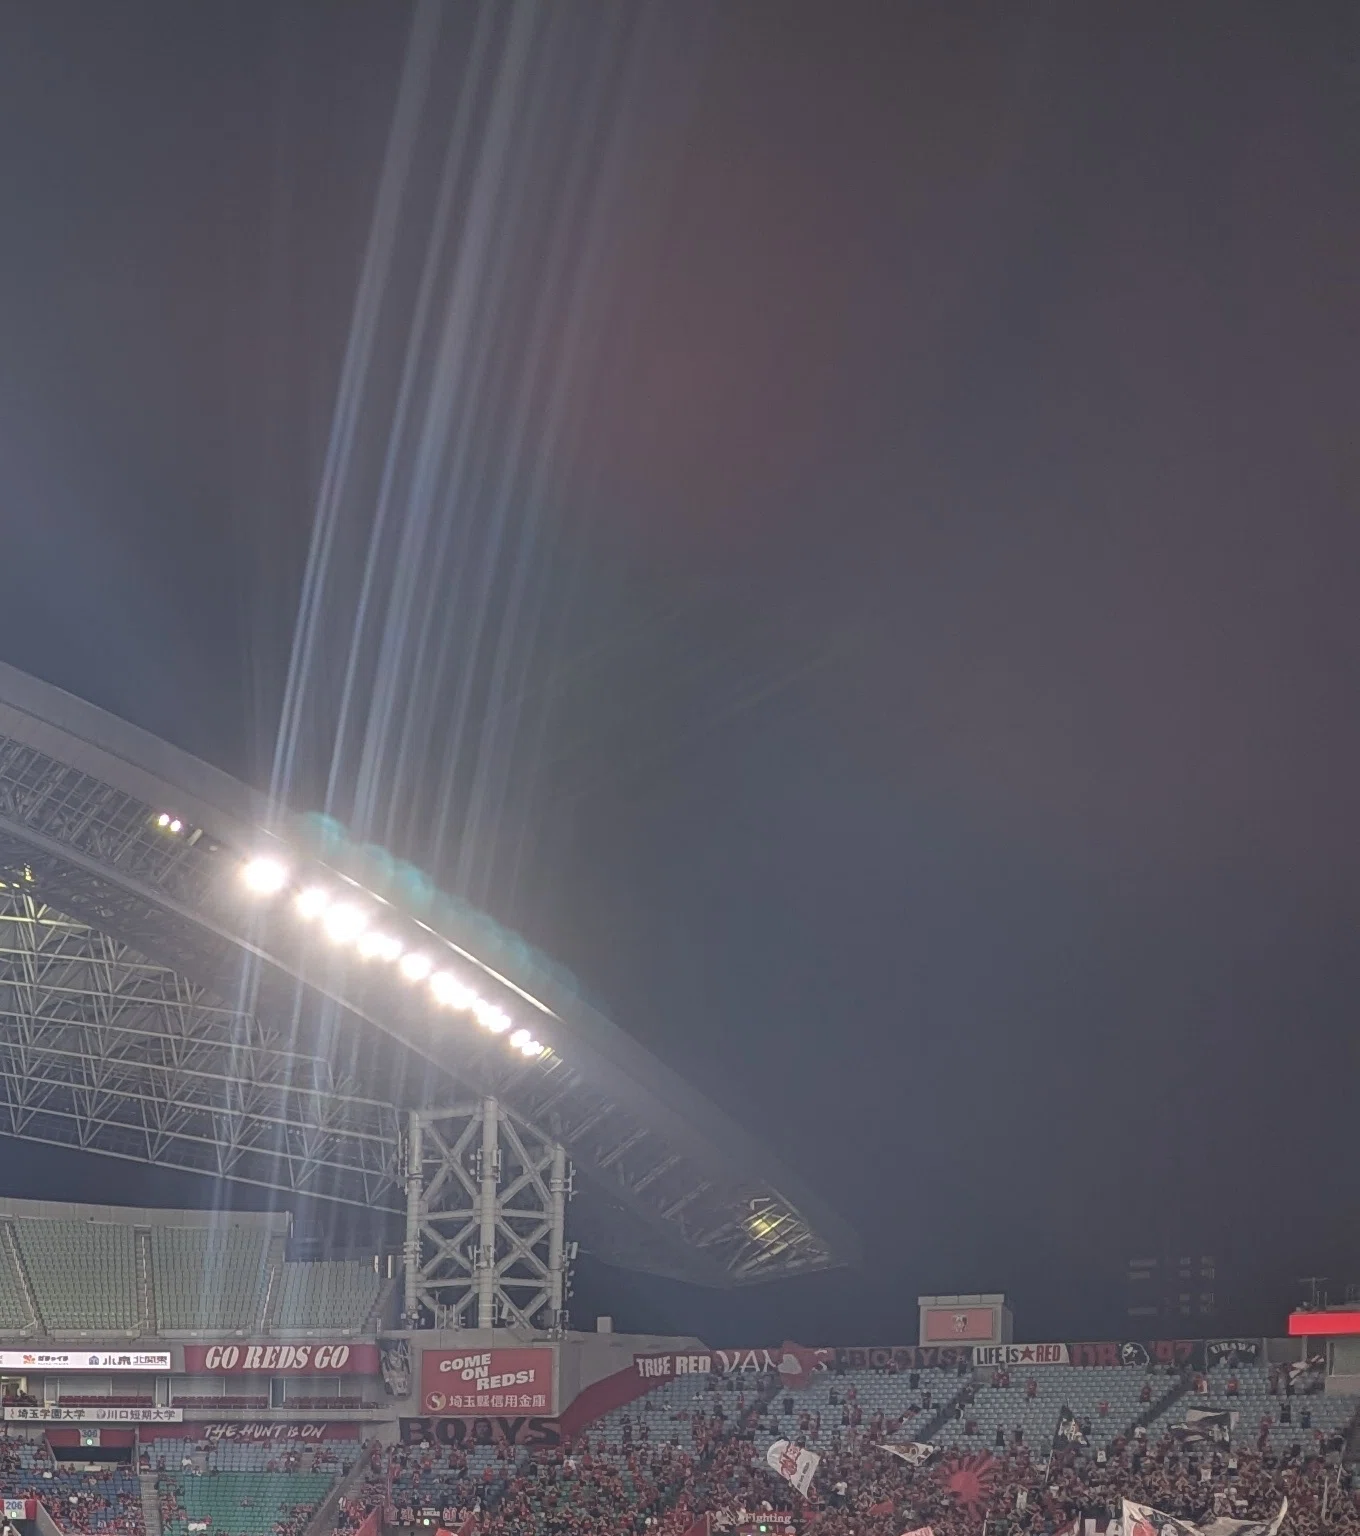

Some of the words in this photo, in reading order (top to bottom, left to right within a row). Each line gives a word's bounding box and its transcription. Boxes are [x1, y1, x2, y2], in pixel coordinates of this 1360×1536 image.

[205, 1345, 240, 1369] GO
[242, 1345, 312, 1369] REDS
[314, 1345, 350, 1369] GO
[439, 1353, 492, 1372] COME
[976, 1345, 1003, 1366] LIFE
[1035, 1344, 1062, 1363] RED
[461, 1366, 489, 1380] ON
[636, 1355, 671, 1378] TRUE
[675, 1355, 711, 1375] RED
[476, 1369, 535, 1391] REDS!
[17, 1409, 86, 1420] 埼玉学園大学
[107, 1409, 176, 1421] 川口短期大学
[204, 1422, 239, 1440] THE
[240, 1422, 287, 1440] HUNT
[301, 1422, 328, 1440] ON
[5, 1501, 23, 1510] 206
[744, 1512, 792, 1525] Fighting
